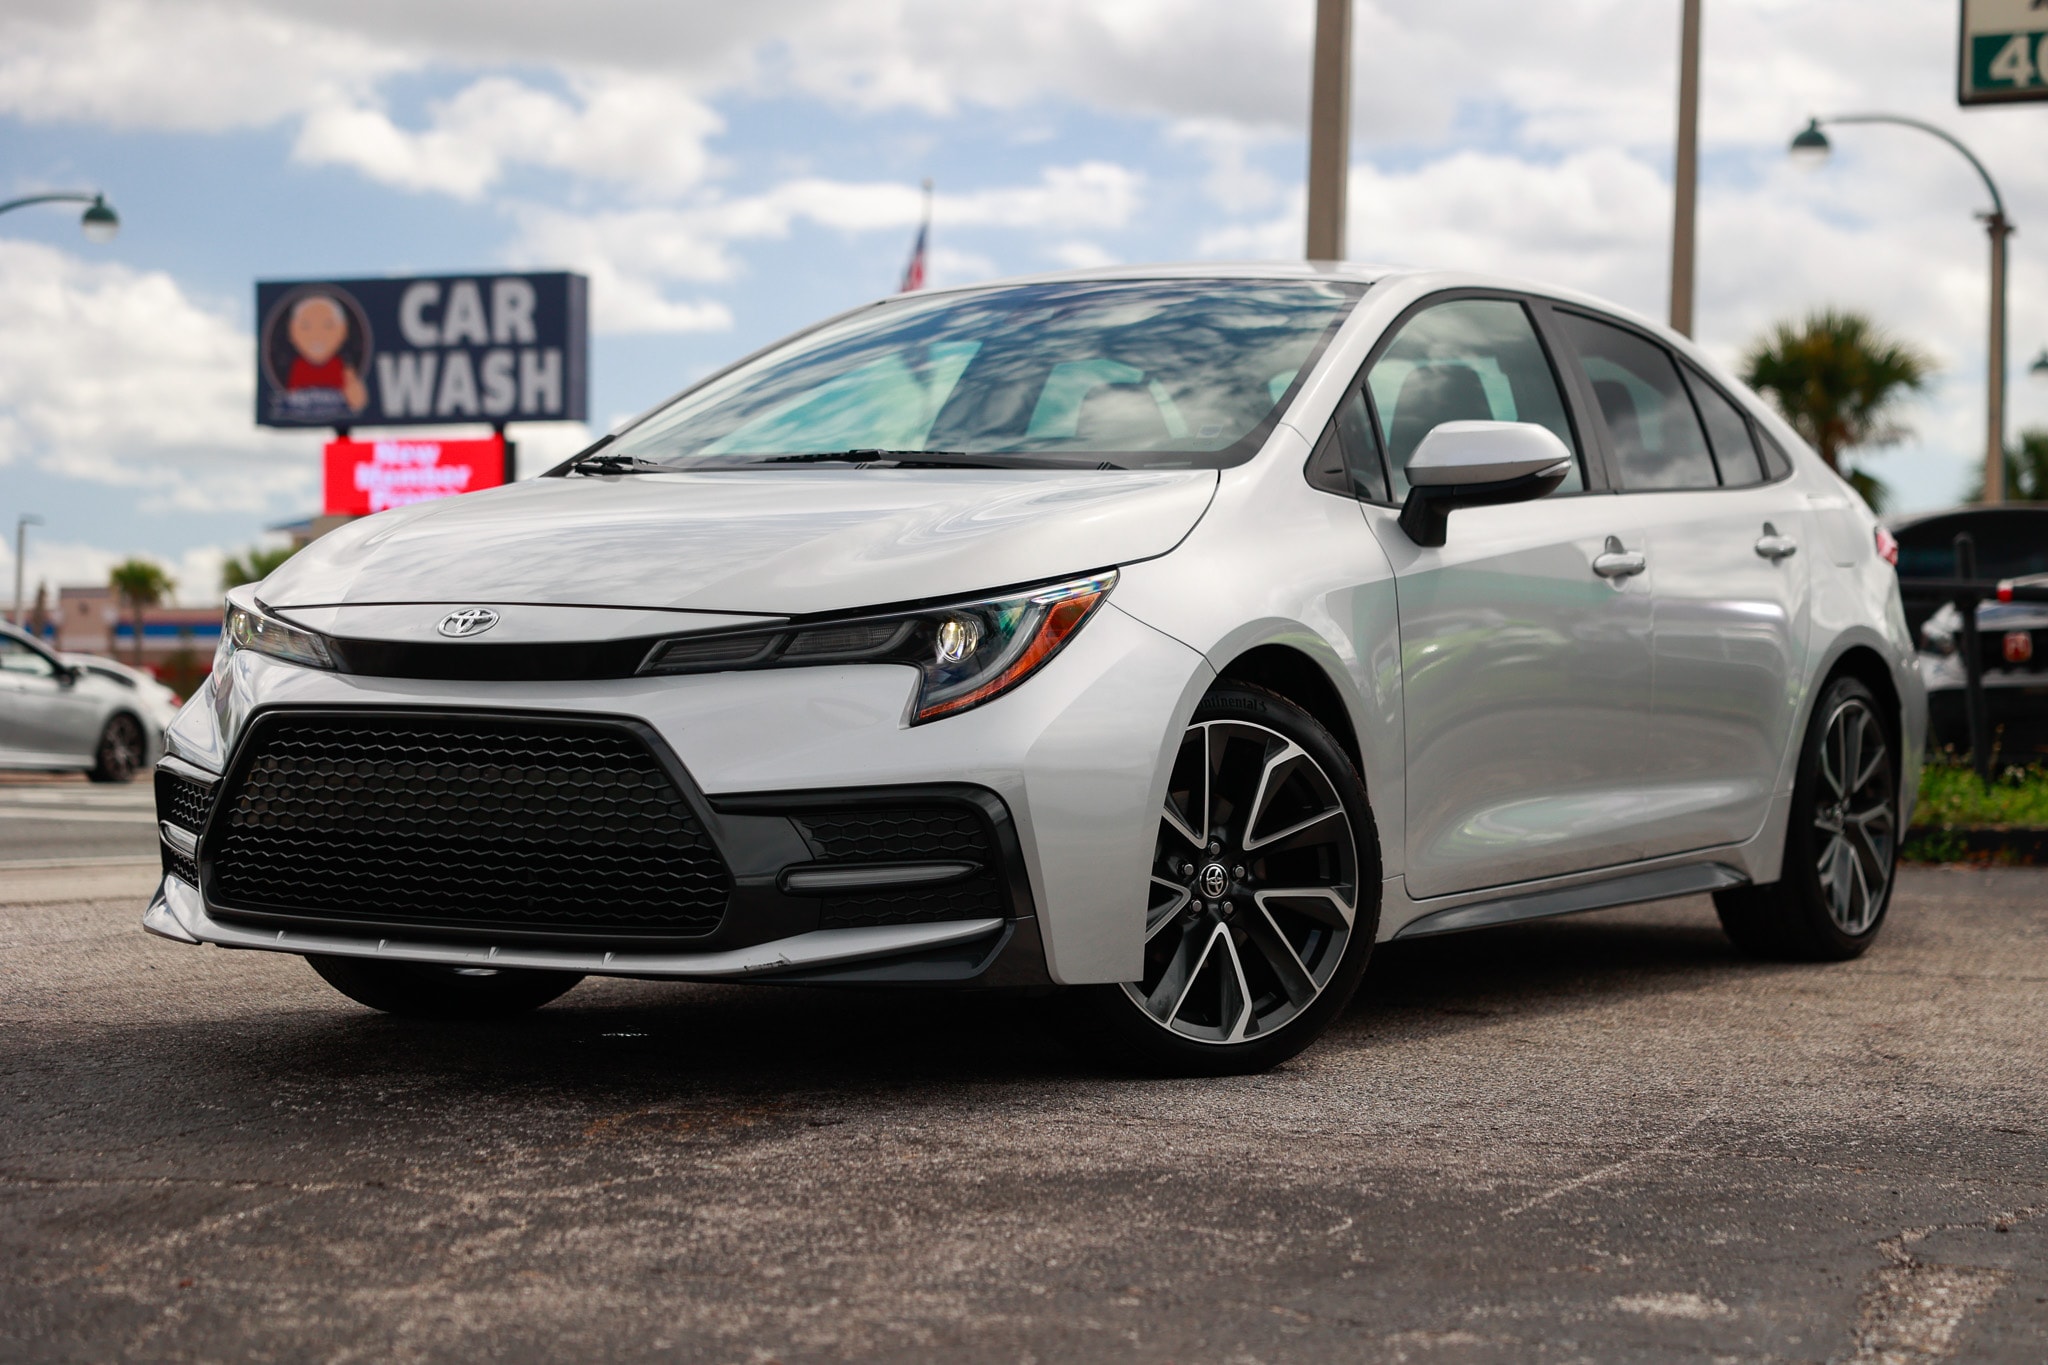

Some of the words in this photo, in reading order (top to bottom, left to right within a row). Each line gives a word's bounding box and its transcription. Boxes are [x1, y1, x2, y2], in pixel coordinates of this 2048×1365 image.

[401, 280, 537, 346] CAR
[378, 350, 563, 417] WASH
[1199, 695, 1257, 711] ntinental
